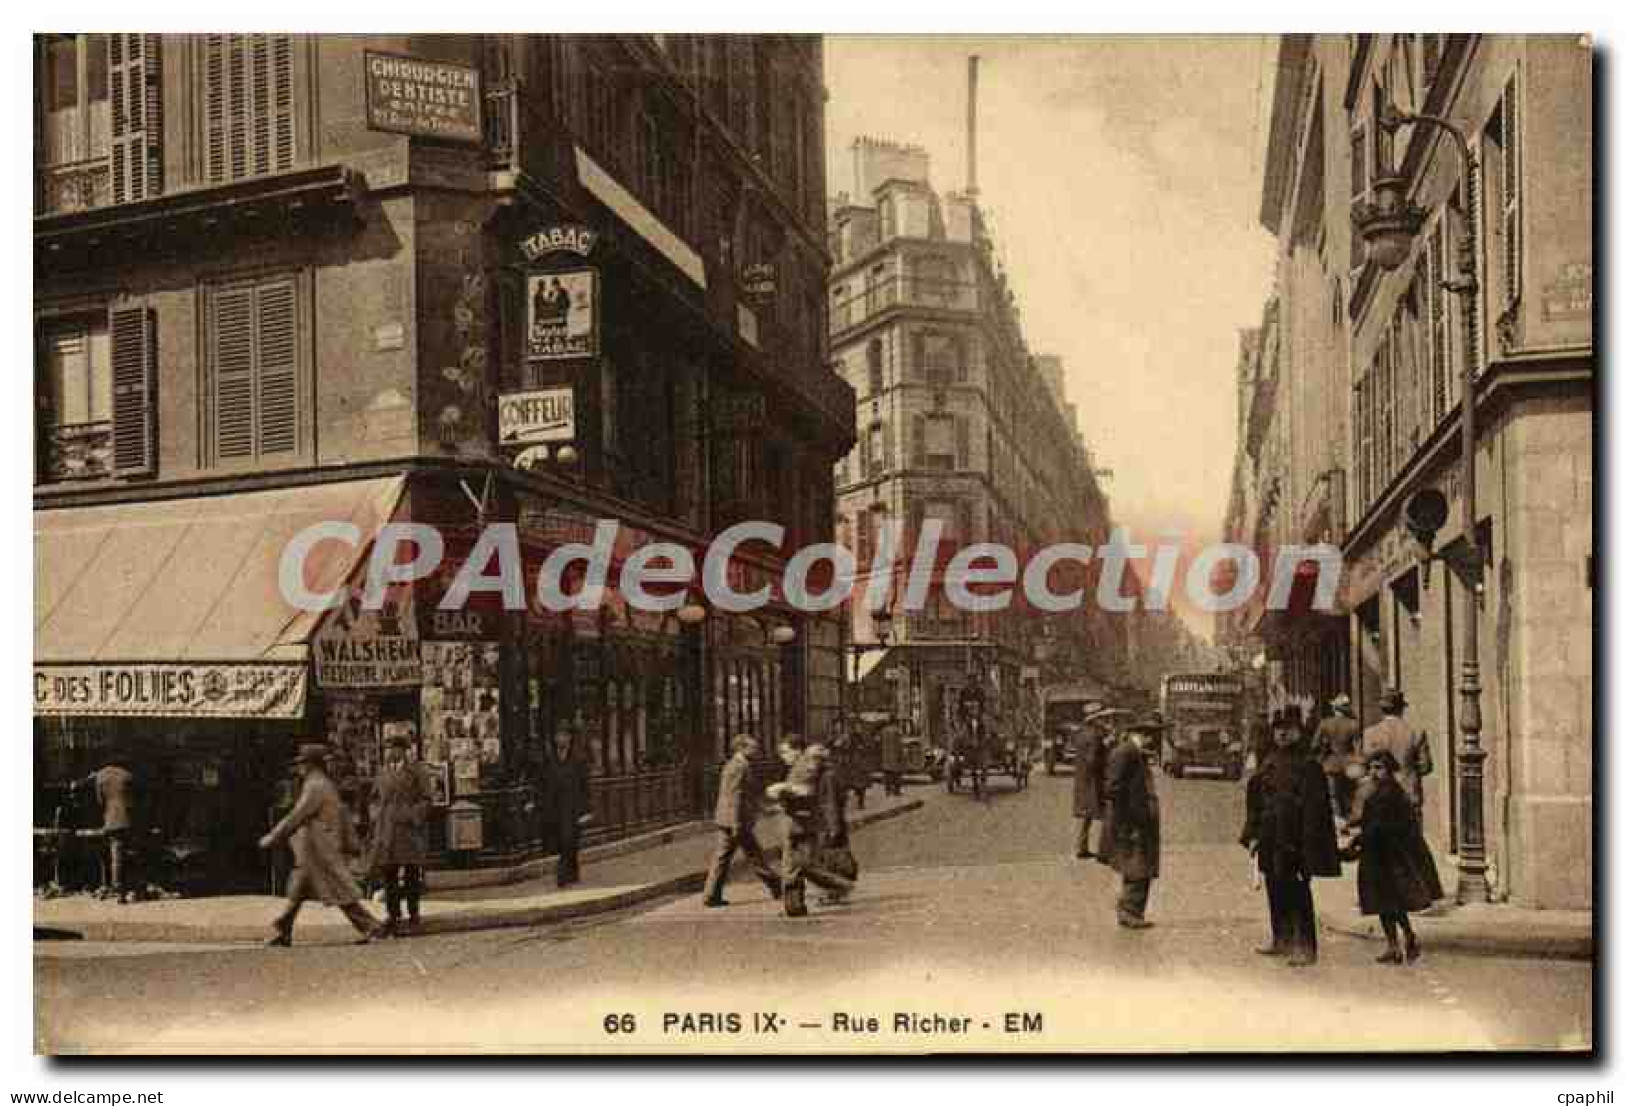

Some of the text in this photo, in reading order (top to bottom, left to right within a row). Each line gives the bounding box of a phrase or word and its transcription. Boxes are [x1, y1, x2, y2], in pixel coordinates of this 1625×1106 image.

[526, 227, 590, 256] TABAC
[432, 613, 482, 634] BAR
[54, 676, 90, 702] DES
[100, 670, 195, 705] FOLIES
